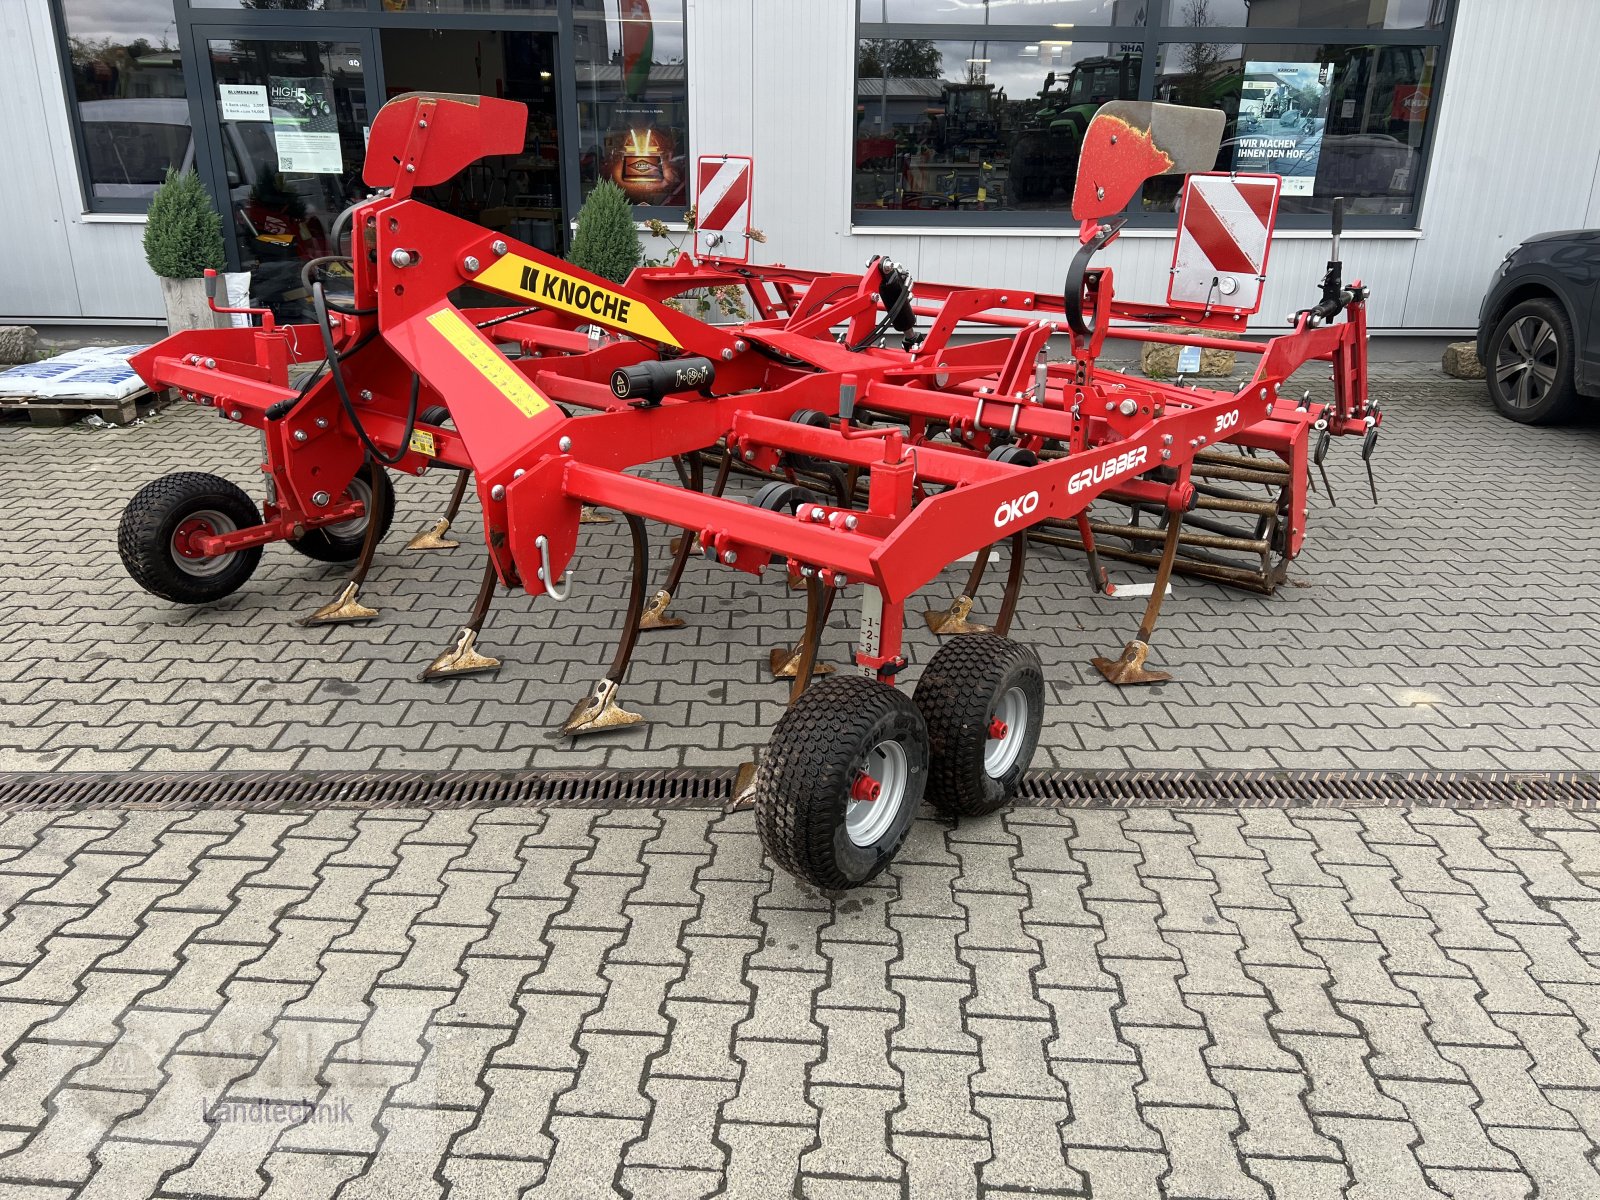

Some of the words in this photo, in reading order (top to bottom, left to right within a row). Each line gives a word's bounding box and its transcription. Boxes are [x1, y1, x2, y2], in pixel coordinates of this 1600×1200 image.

[1239, 139, 1258, 147] WIR
[1259, 139, 1296, 148] MACHEN
[1238, 149, 1266, 158] IHNEN
[1267, 149, 1285, 158] DEN
[1286, 150, 1305, 158] HOF.
[542, 273, 631, 323] KNOCHE
[993, 490, 1039, 528] ÖKO
[1067, 445, 1148, 495] GRUBBER
[1214, 409, 1239, 433] 300
[866, 630, 873, 640] 2
[865, 643, 872, 652] 3
[863, 668, 870, 677] 5
